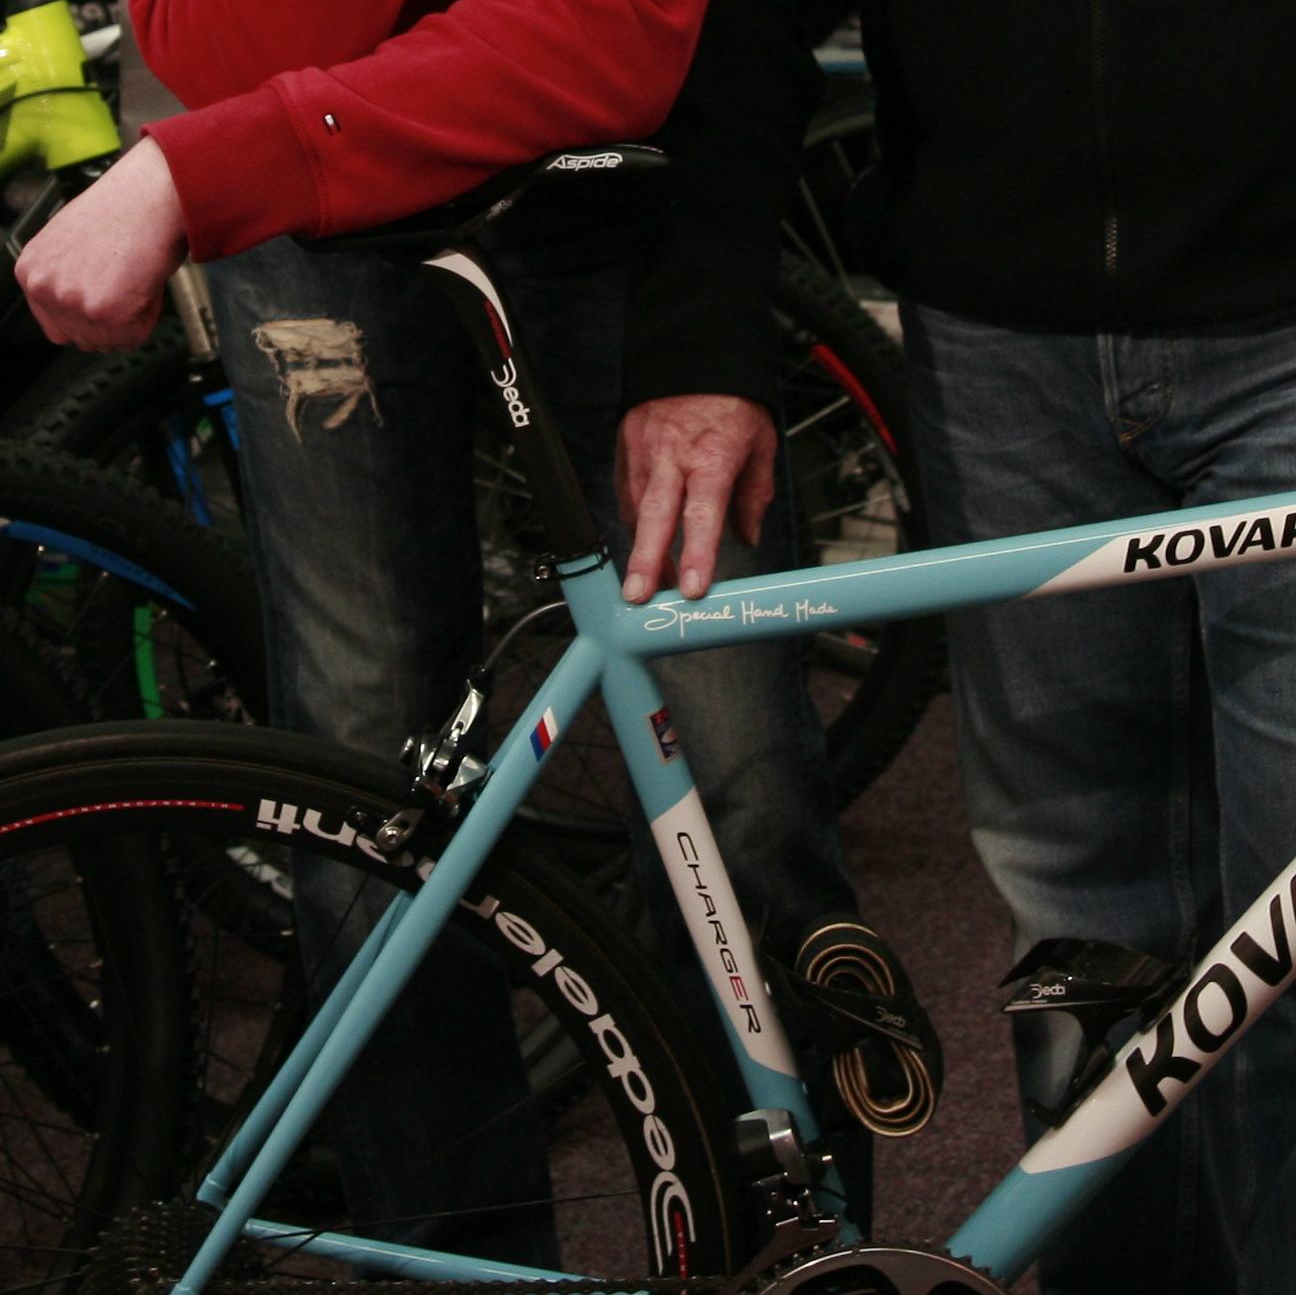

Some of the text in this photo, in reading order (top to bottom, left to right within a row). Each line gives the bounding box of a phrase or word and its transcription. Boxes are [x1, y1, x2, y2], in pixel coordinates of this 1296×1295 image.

[545, 153, 623, 172] Aspide
[491, 357, 531, 428] Deda
[644, 599, 839, 639] Special Hand Made
[677, 832, 761, 1034] CHARGER
